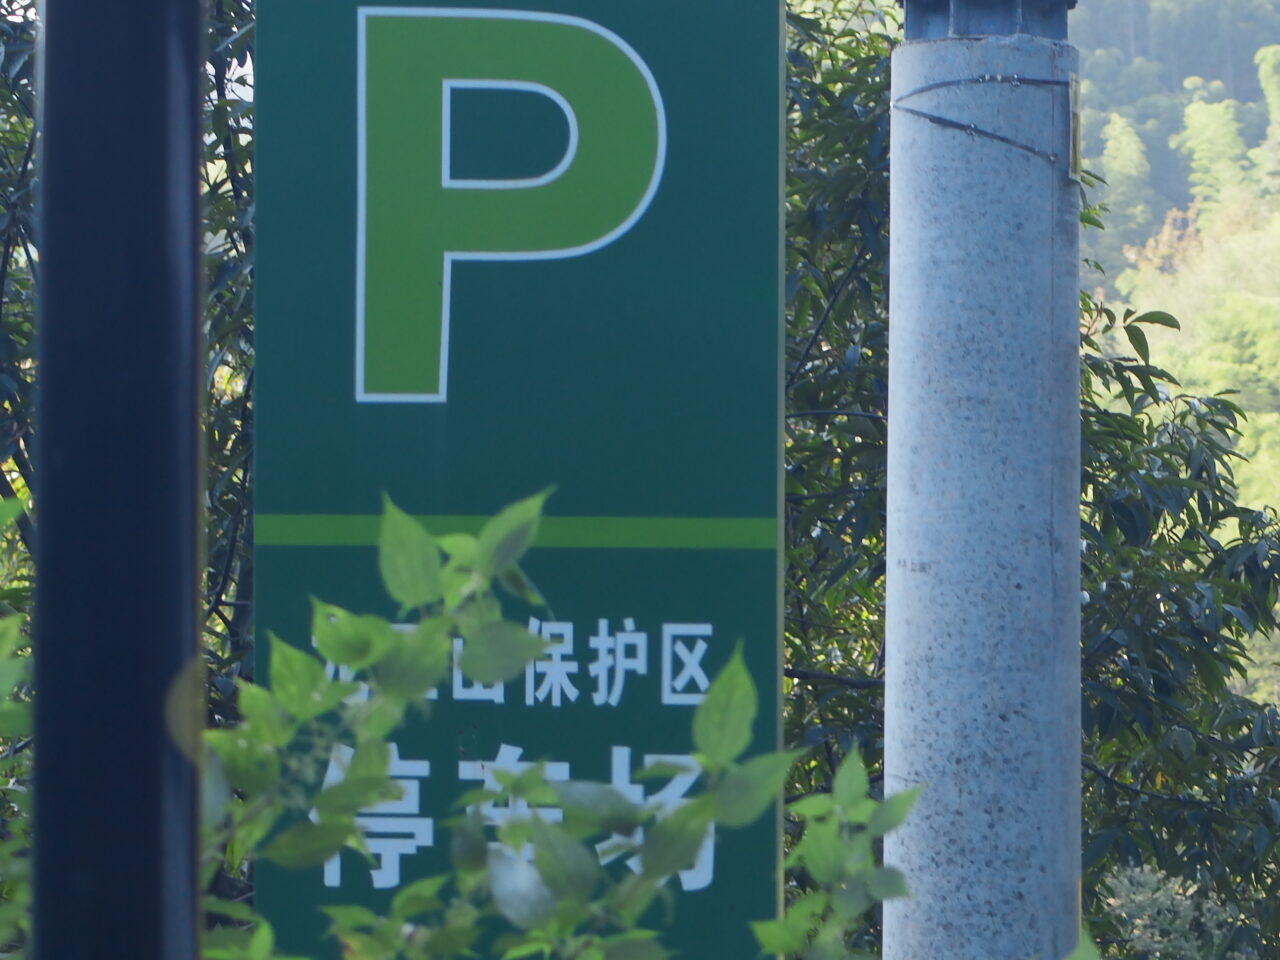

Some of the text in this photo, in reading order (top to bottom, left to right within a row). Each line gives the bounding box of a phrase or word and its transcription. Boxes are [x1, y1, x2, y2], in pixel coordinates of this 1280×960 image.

[357, 6, 666, 402] P
[312, 616, 713, 706] 山保护区
